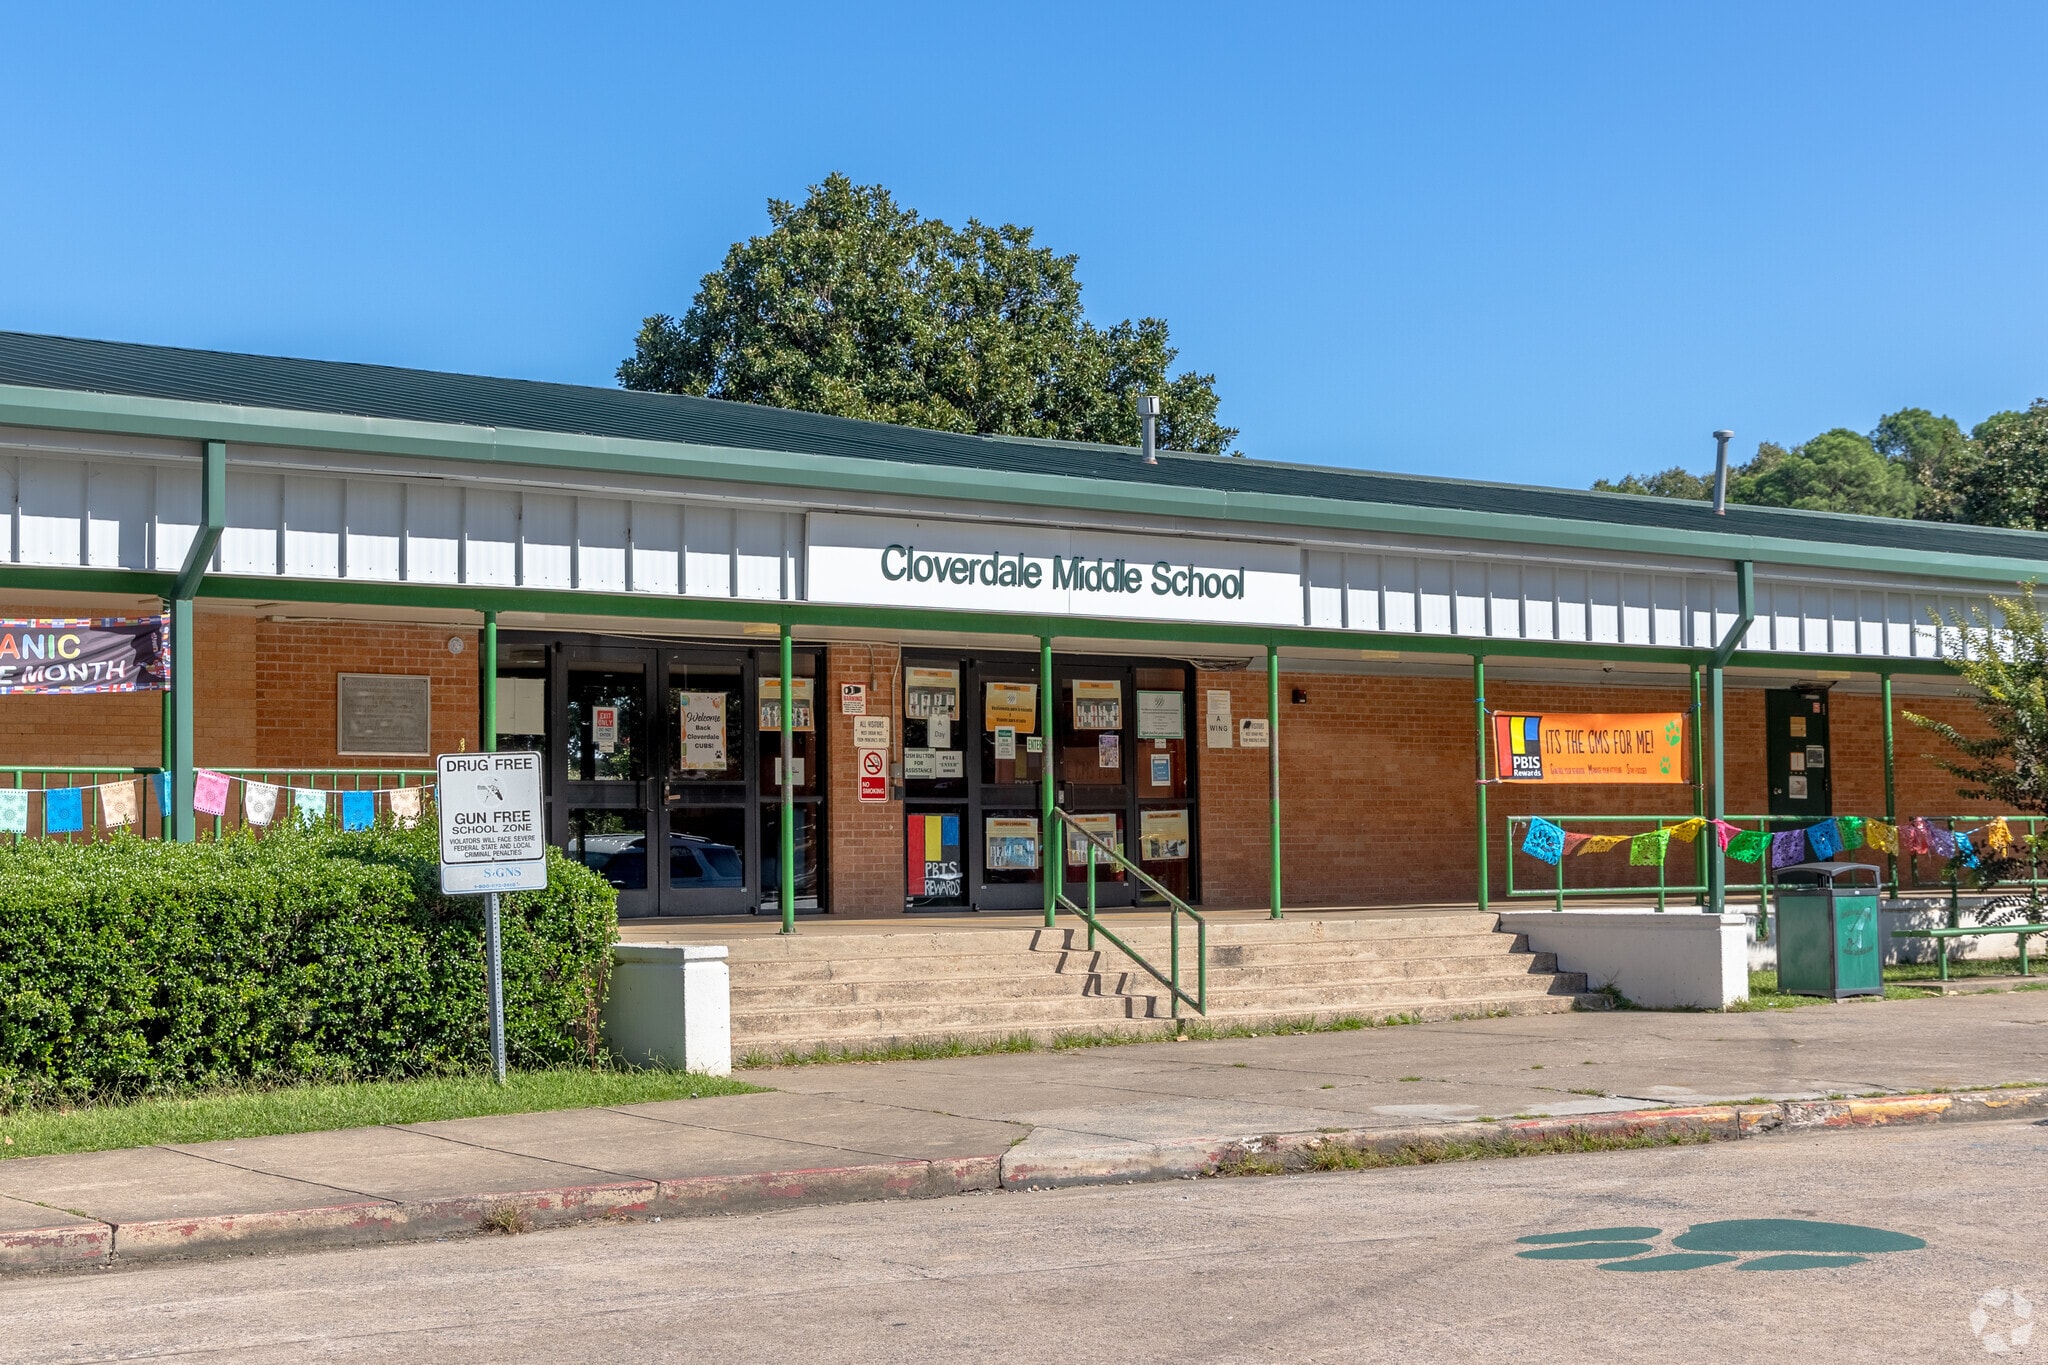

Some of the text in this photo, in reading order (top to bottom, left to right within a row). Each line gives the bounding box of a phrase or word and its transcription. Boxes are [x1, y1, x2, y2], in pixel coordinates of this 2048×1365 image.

[881, 544, 1245, 600] Cloverdale Middle School
[0, 634, 81, 660] ANIC
[21, 660, 126, 684] MONTH
[686, 711, 721, 723] Welcome
[868, 720, 885, 729] VISITORS
[1027, 739, 1042, 750] ENTER
[1545, 729, 1654, 754] ITS THE CMS FOR ME!
[446, 757, 533, 772] DRUG FREE
[1513, 756, 1541, 769] PBIS
[1513, 769, 1541, 777] Rewards
[454, 810, 531, 825] GUN FREE
[452, 823, 532, 835] SCHOOL ZONE
[449, 837, 481, 845] VIOLATORS
[482, 836, 496, 844] WILL
[513, 834, 536, 842] SEVERE
[464, 849, 522, 858] CRIMINAL PENALTIES
[481, 843, 497, 851] STATE
[925, 861, 957, 879] PBIS
[924, 879, 961, 896] REWARDS
